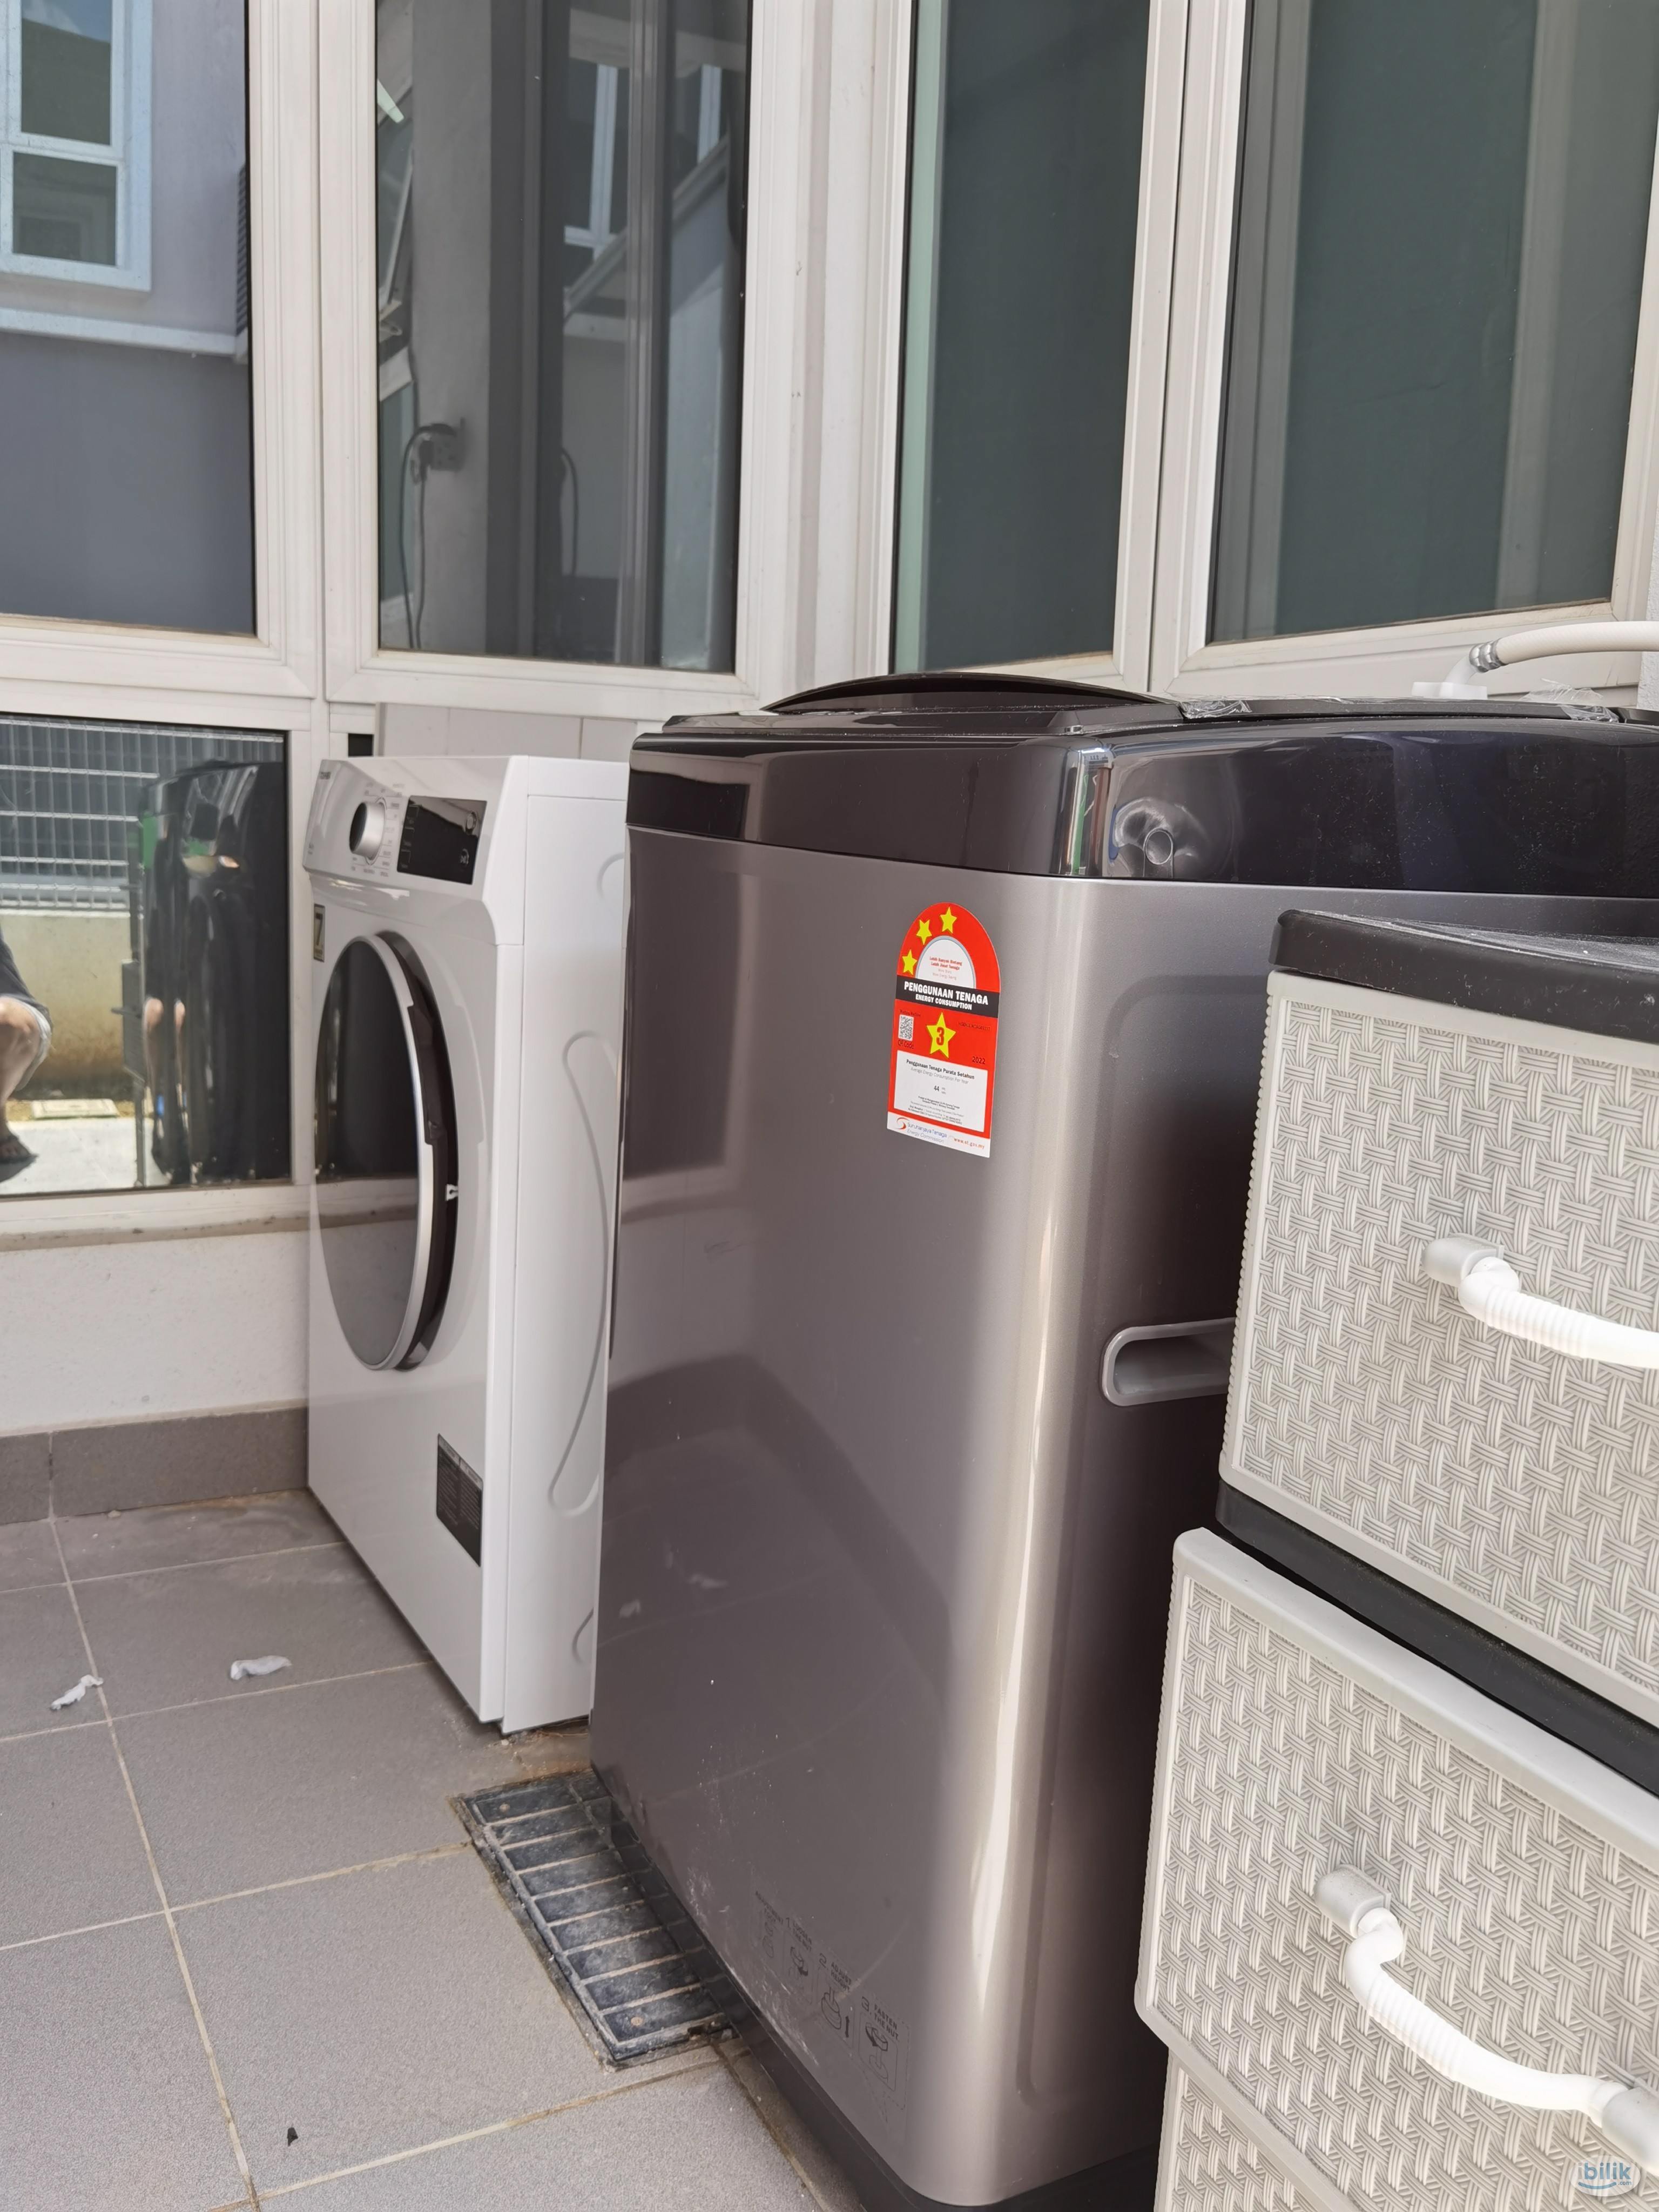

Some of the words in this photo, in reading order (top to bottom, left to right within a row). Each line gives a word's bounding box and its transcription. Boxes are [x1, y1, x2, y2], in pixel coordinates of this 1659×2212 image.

[904, 981, 953, 999] PENGGUNAAN
[955, 990, 988, 1005] TENAGA
[915, 994, 934, 1003] ENERGY
[935, 998, 972, 1010] CONSUMPTION
[936, 1027, 945, 1046] 3
[972, 1056, 986, 1064] 2022
[906, 1059, 928, 1069] Penggunaan
[957, 1071, 975, 1080] Setahun
[934, 1073, 954, 1081] Consumption
[907, 1129, 920, 1137] Energy
[920, 1132, 944, 1143] Commission
[954, 1138, 984, 1149] www.st.gov.my
[831, 1961, 852, 1985] ADJUST
[874, 2003, 897, 2031] FASTEN
[874, 2013, 886, 2029] THE
